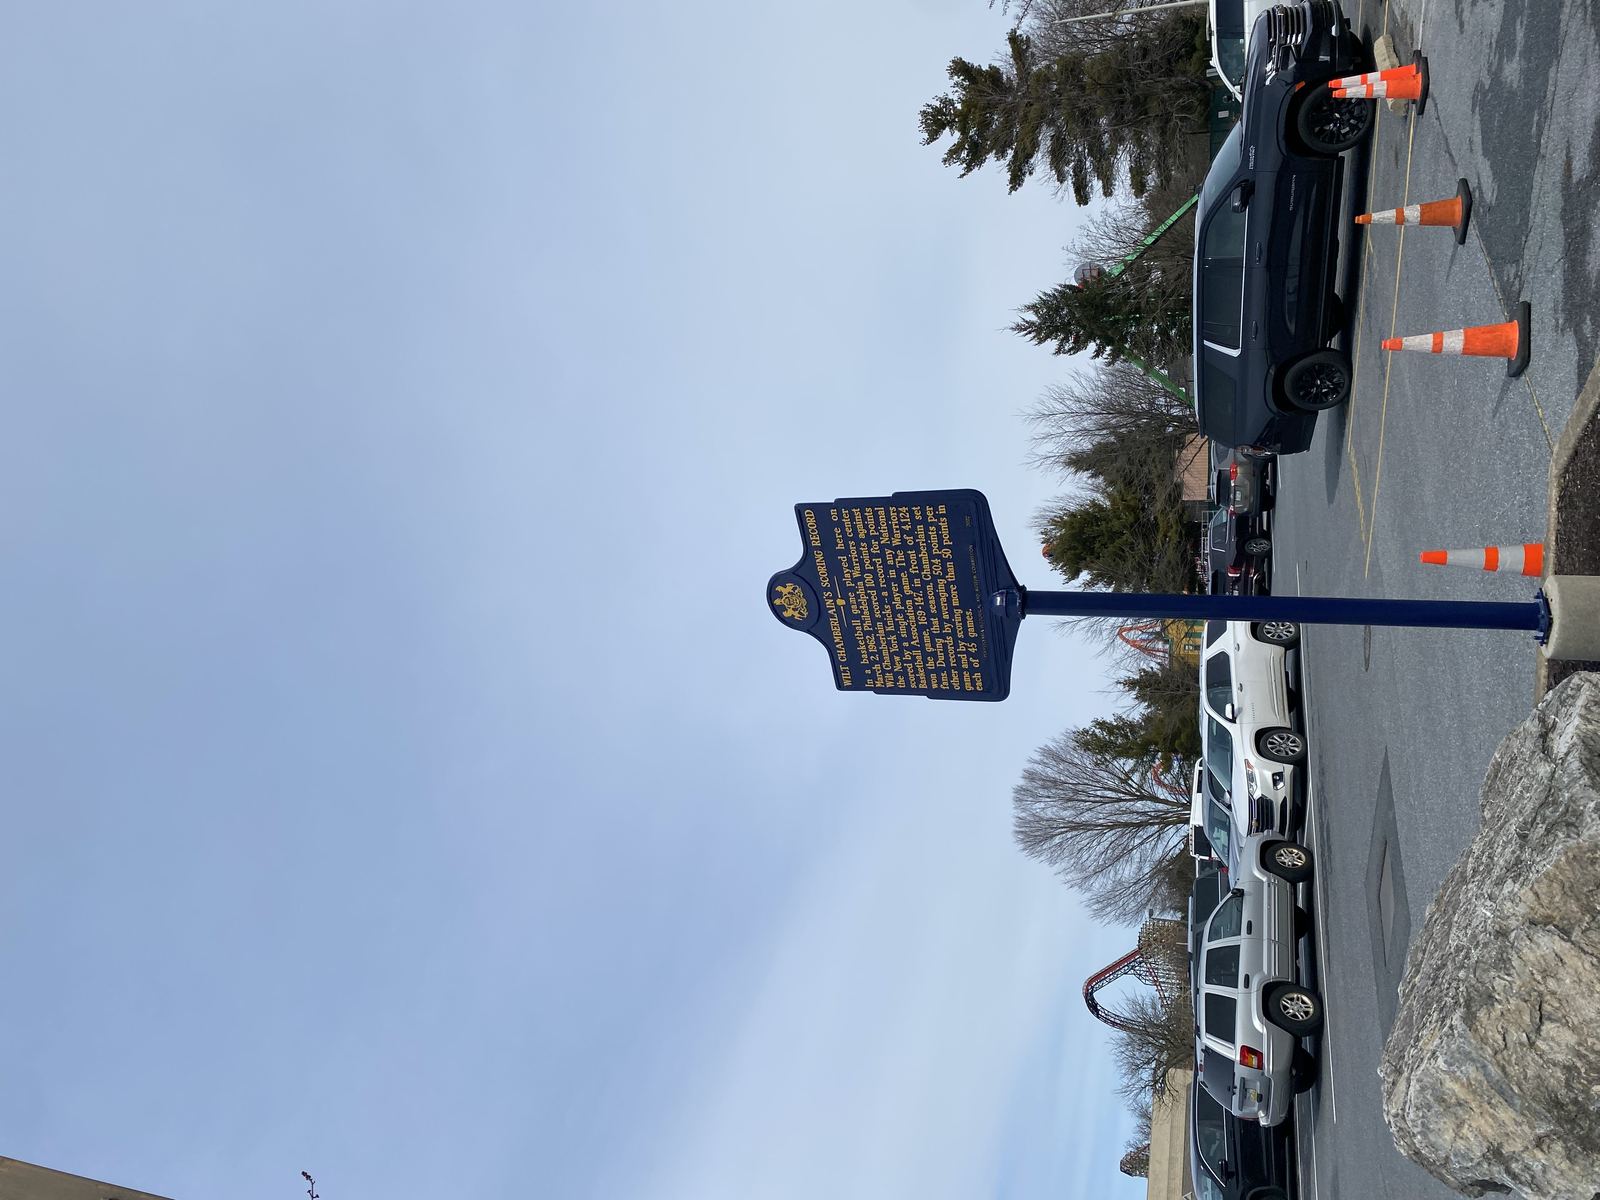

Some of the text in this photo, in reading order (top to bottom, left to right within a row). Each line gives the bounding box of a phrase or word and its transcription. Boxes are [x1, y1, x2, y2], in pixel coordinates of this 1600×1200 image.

[830, 509, 838, 521] on
[842, 508, 853, 537] center
[864, 507, 879, 535] points
[912, 506, 922, 520] set
[926, 506, 938, 522] per
[874, 507, 890, 544] National
[834, 527, 845, 549] here
[870, 539, 880, 553] for
[903, 534, 914, 545] of
[928, 526, 942, 554] points
[848, 541, 861, 578] Warriors
[885, 548, 895, 565] any
[907, 550, 919, 574] front
[915, 525, 932, 580] Chamberlain
[838, 556, 855, 586] played
[872, 558, 886, 587] record
[887, 569, 896, 578] in
[912, 578, 921, 587] in
[804, 509, 851, 686] WILT CHAMBERLAIN'S SCORING RECORD
[848, 592, 861, 614] game
[852, 508, 894, 688] Wilt Chamberlain scored 100 points against
[855, 581, 873, 631] Philadelphia
[889, 506, 928, 688] Basketball Association game. The Warriors
[891, 582, 904, 609] player
[936, 505, 974, 691] game and by scoring more than 50 points in
[936, 579, 949, 619] averaging
[882, 605, 895, 631] Knicks
[895, 613, 908, 637] single
[931, 618, 940, 634] that
[942, 622, 952, 633] by
[851, 620, 869, 664] basketball
[887, 635, 899, 652] York
[934, 638, 946, 667] During
[944, 636, 956, 666] records
[966, 608, 983, 691] each of 45 games.
[893, 655, 902, 672] New
[902, 649, 912, 660] by
[926, 656, 935, 669] the
[865, 679, 874, 687] In
[872, 664, 884, 687] March
[896, 675, 906, 688] the
[903, 663, 917, 688] scored
[930, 673, 938, 689] won
[940, 670, 949, 689] fans.
[950, 669, 960, 690] other
